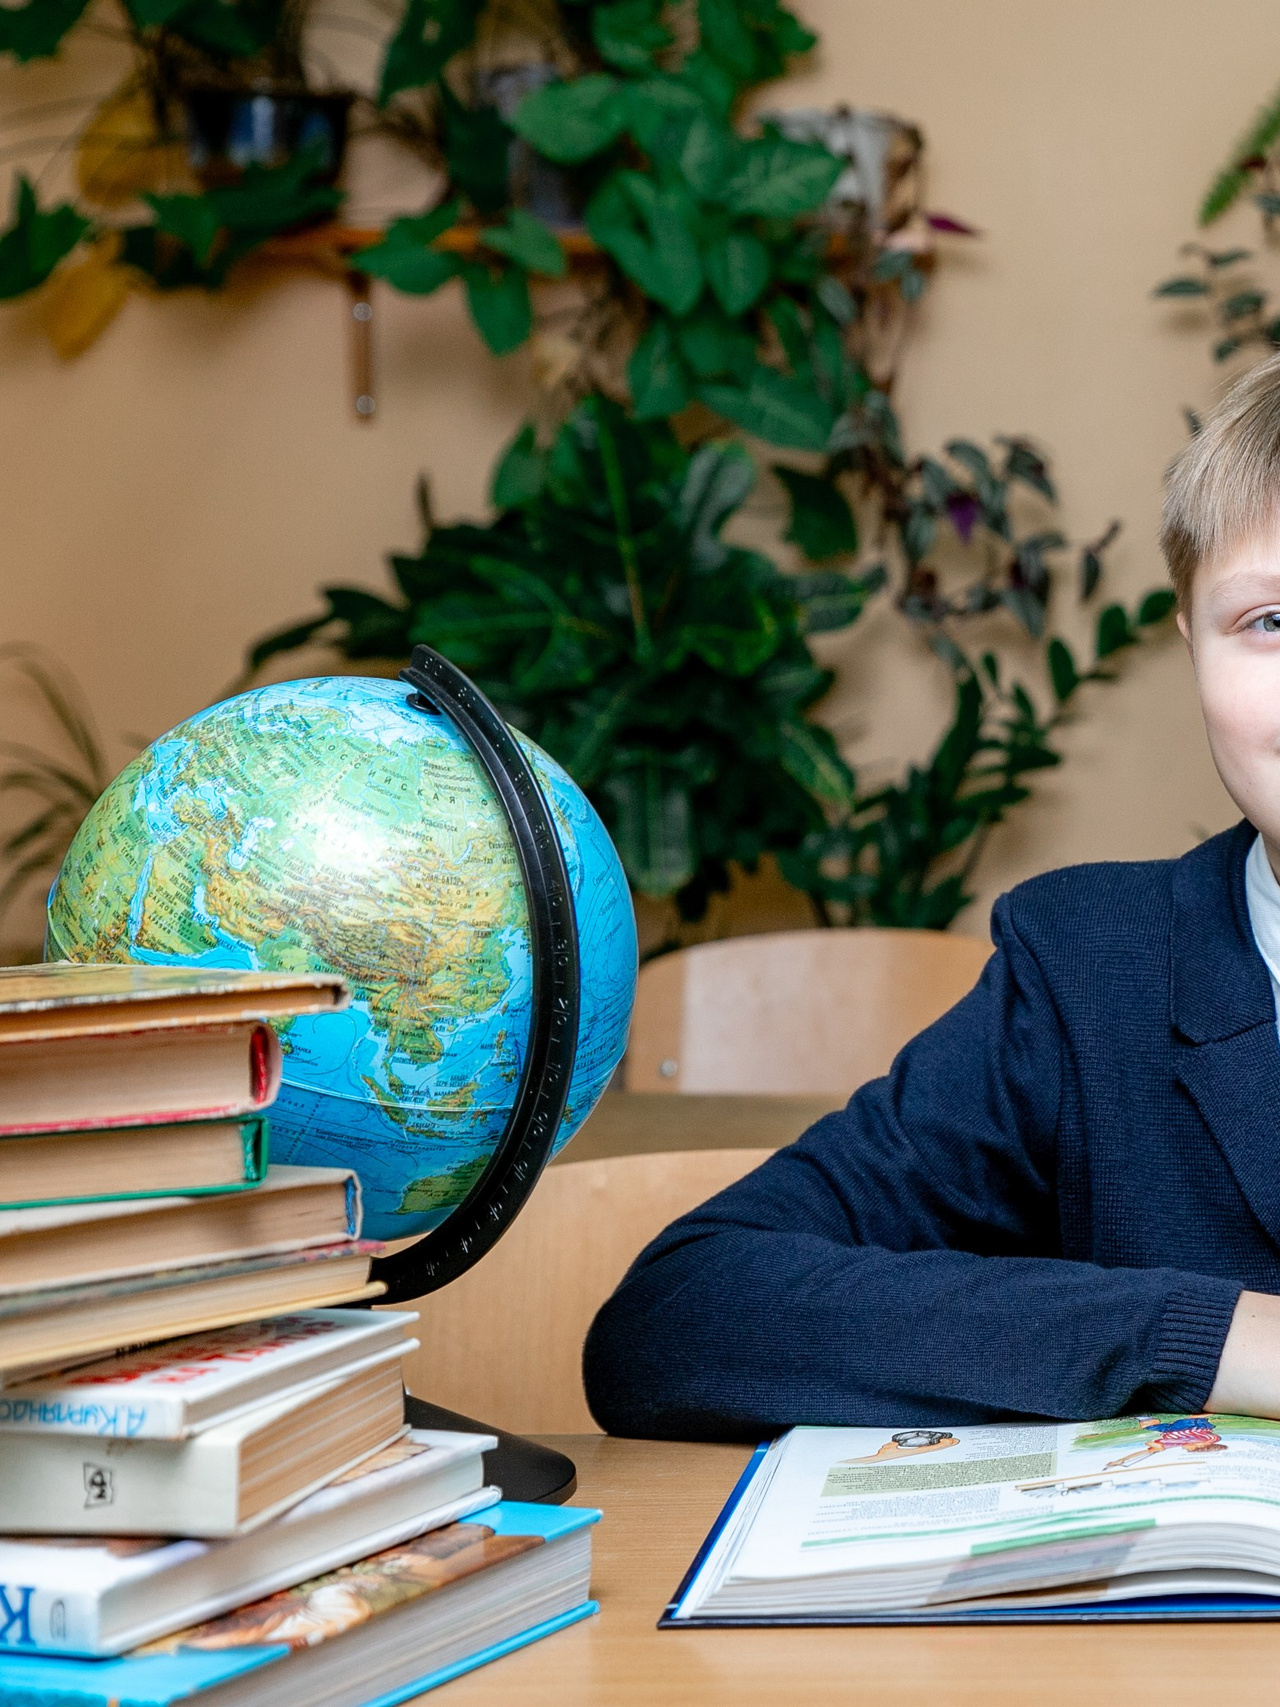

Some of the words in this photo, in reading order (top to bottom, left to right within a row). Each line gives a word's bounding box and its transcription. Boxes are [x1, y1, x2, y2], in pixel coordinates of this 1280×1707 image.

[184, 862, 199, 876] ИРАК
[211, 887, 240, 908] ИРАН
[148, 891, 193, 928] САУДОВСКАЯ
[147, 914, 171, 934] АРАВИЯ
